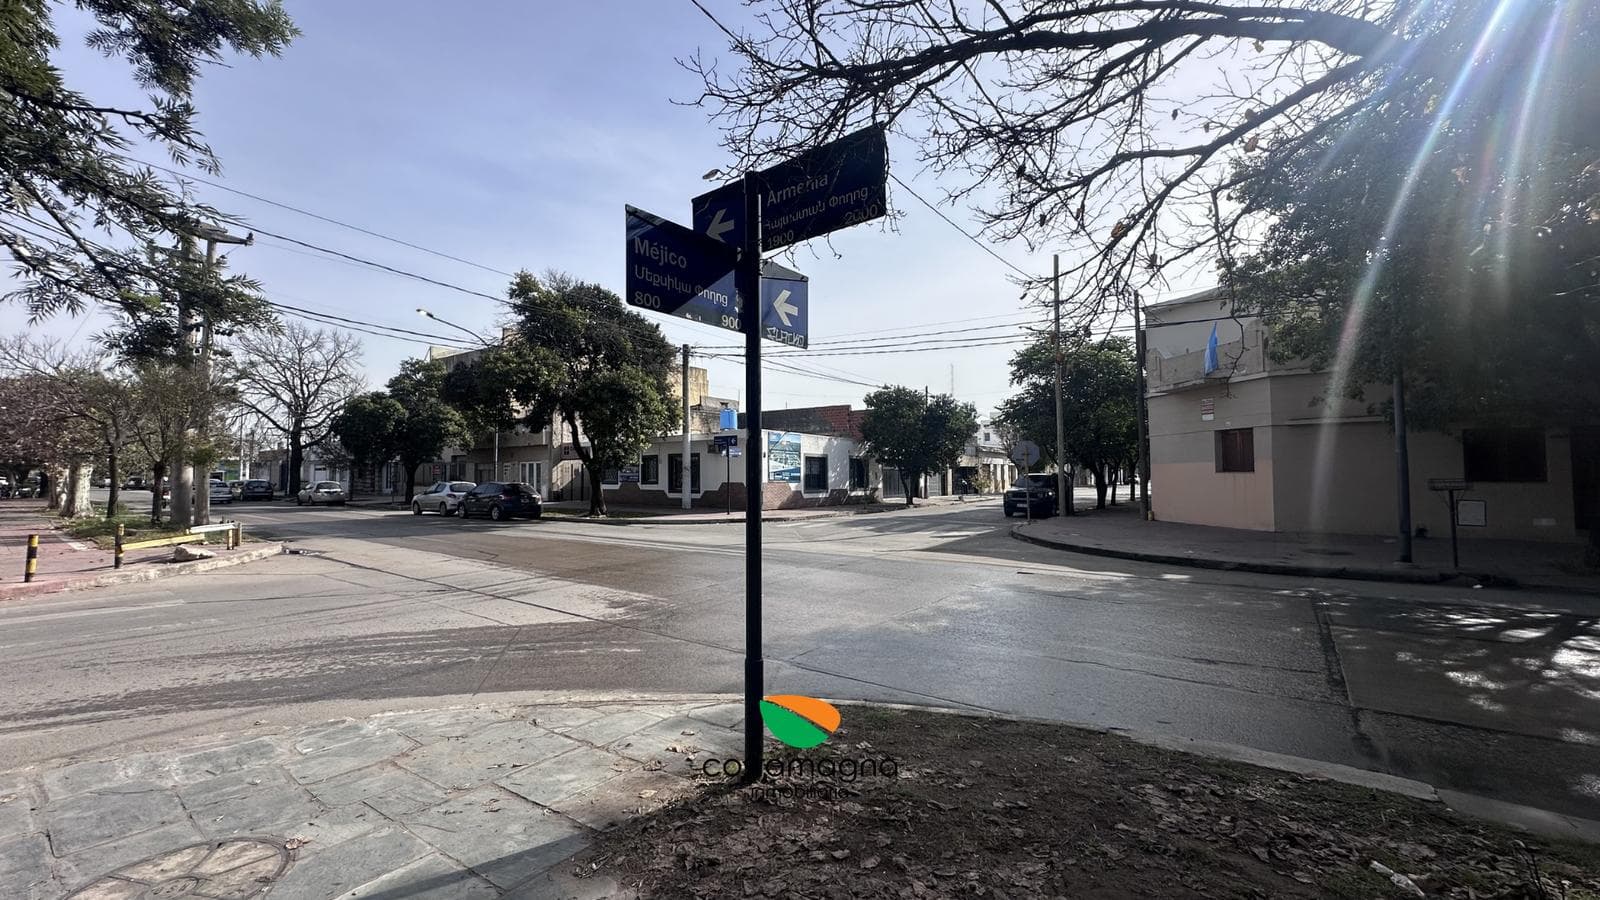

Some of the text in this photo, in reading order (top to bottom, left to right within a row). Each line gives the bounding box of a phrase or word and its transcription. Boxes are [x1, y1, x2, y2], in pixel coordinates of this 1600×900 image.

[634, 237, 688, 269] Méjico
[634, 291, 661, 309] 800
[721, 315, 742, 329] 900
